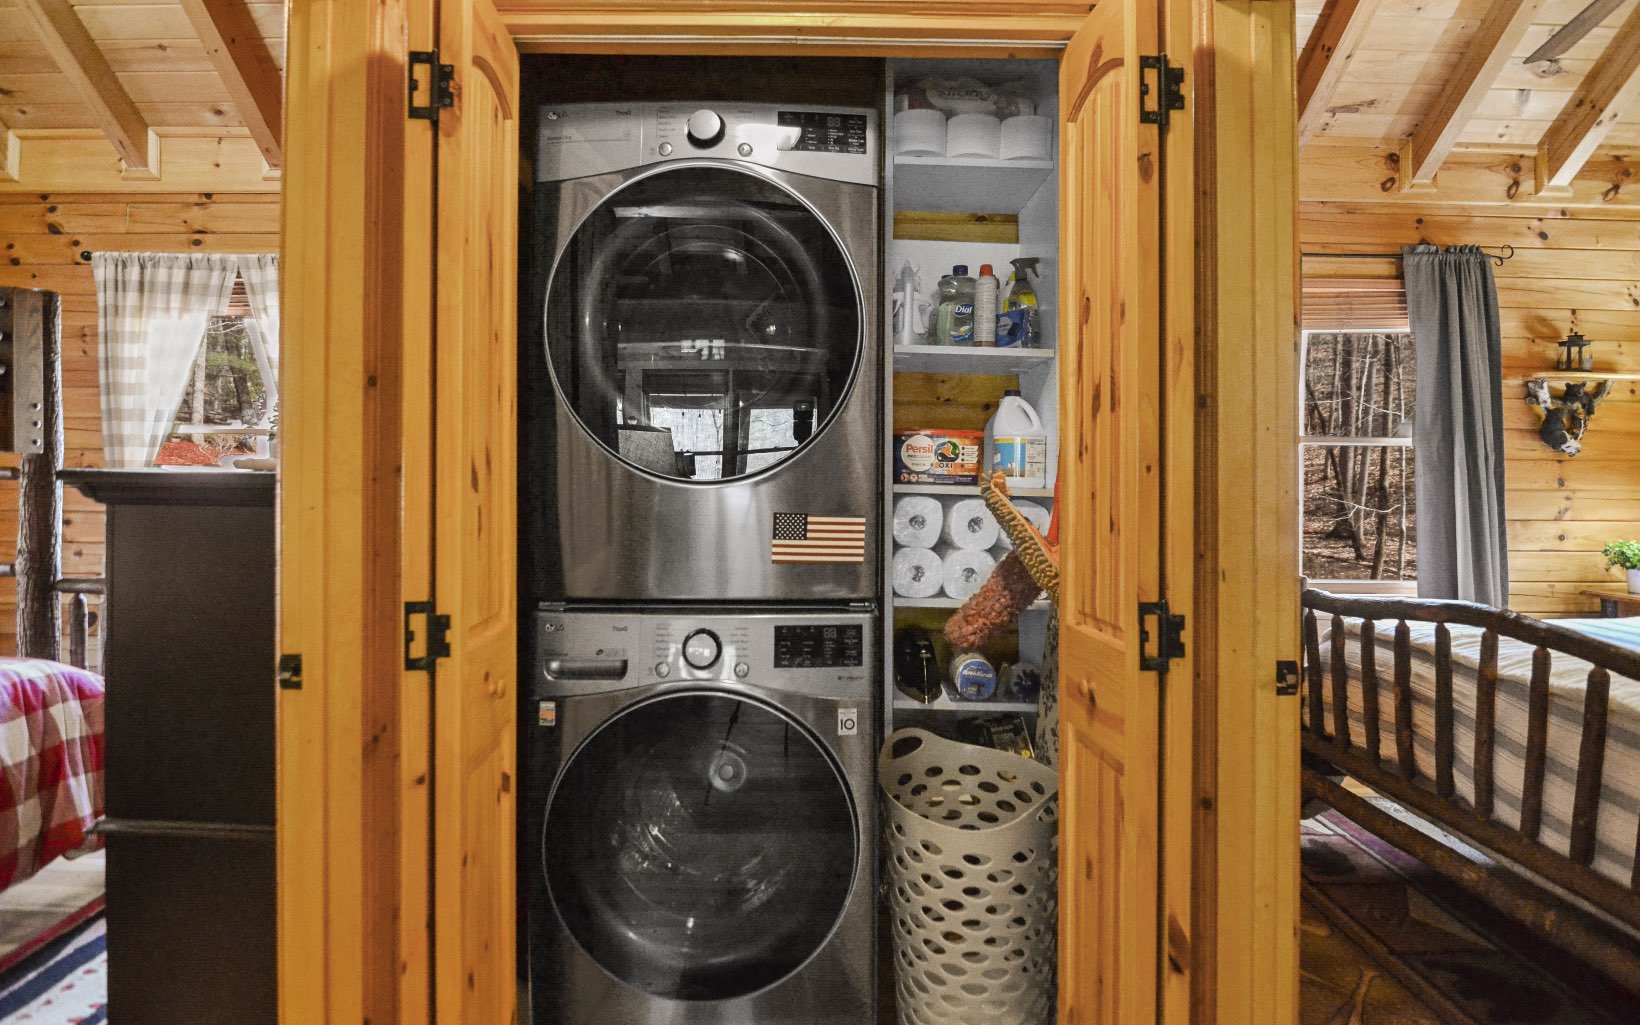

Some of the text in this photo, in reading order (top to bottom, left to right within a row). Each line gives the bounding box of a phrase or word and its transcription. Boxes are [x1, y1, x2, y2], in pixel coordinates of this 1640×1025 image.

[955, 304, 973, 315] Dial
[906, 444, 934, 453] Persil
[840, 718, 855, 731] 10
